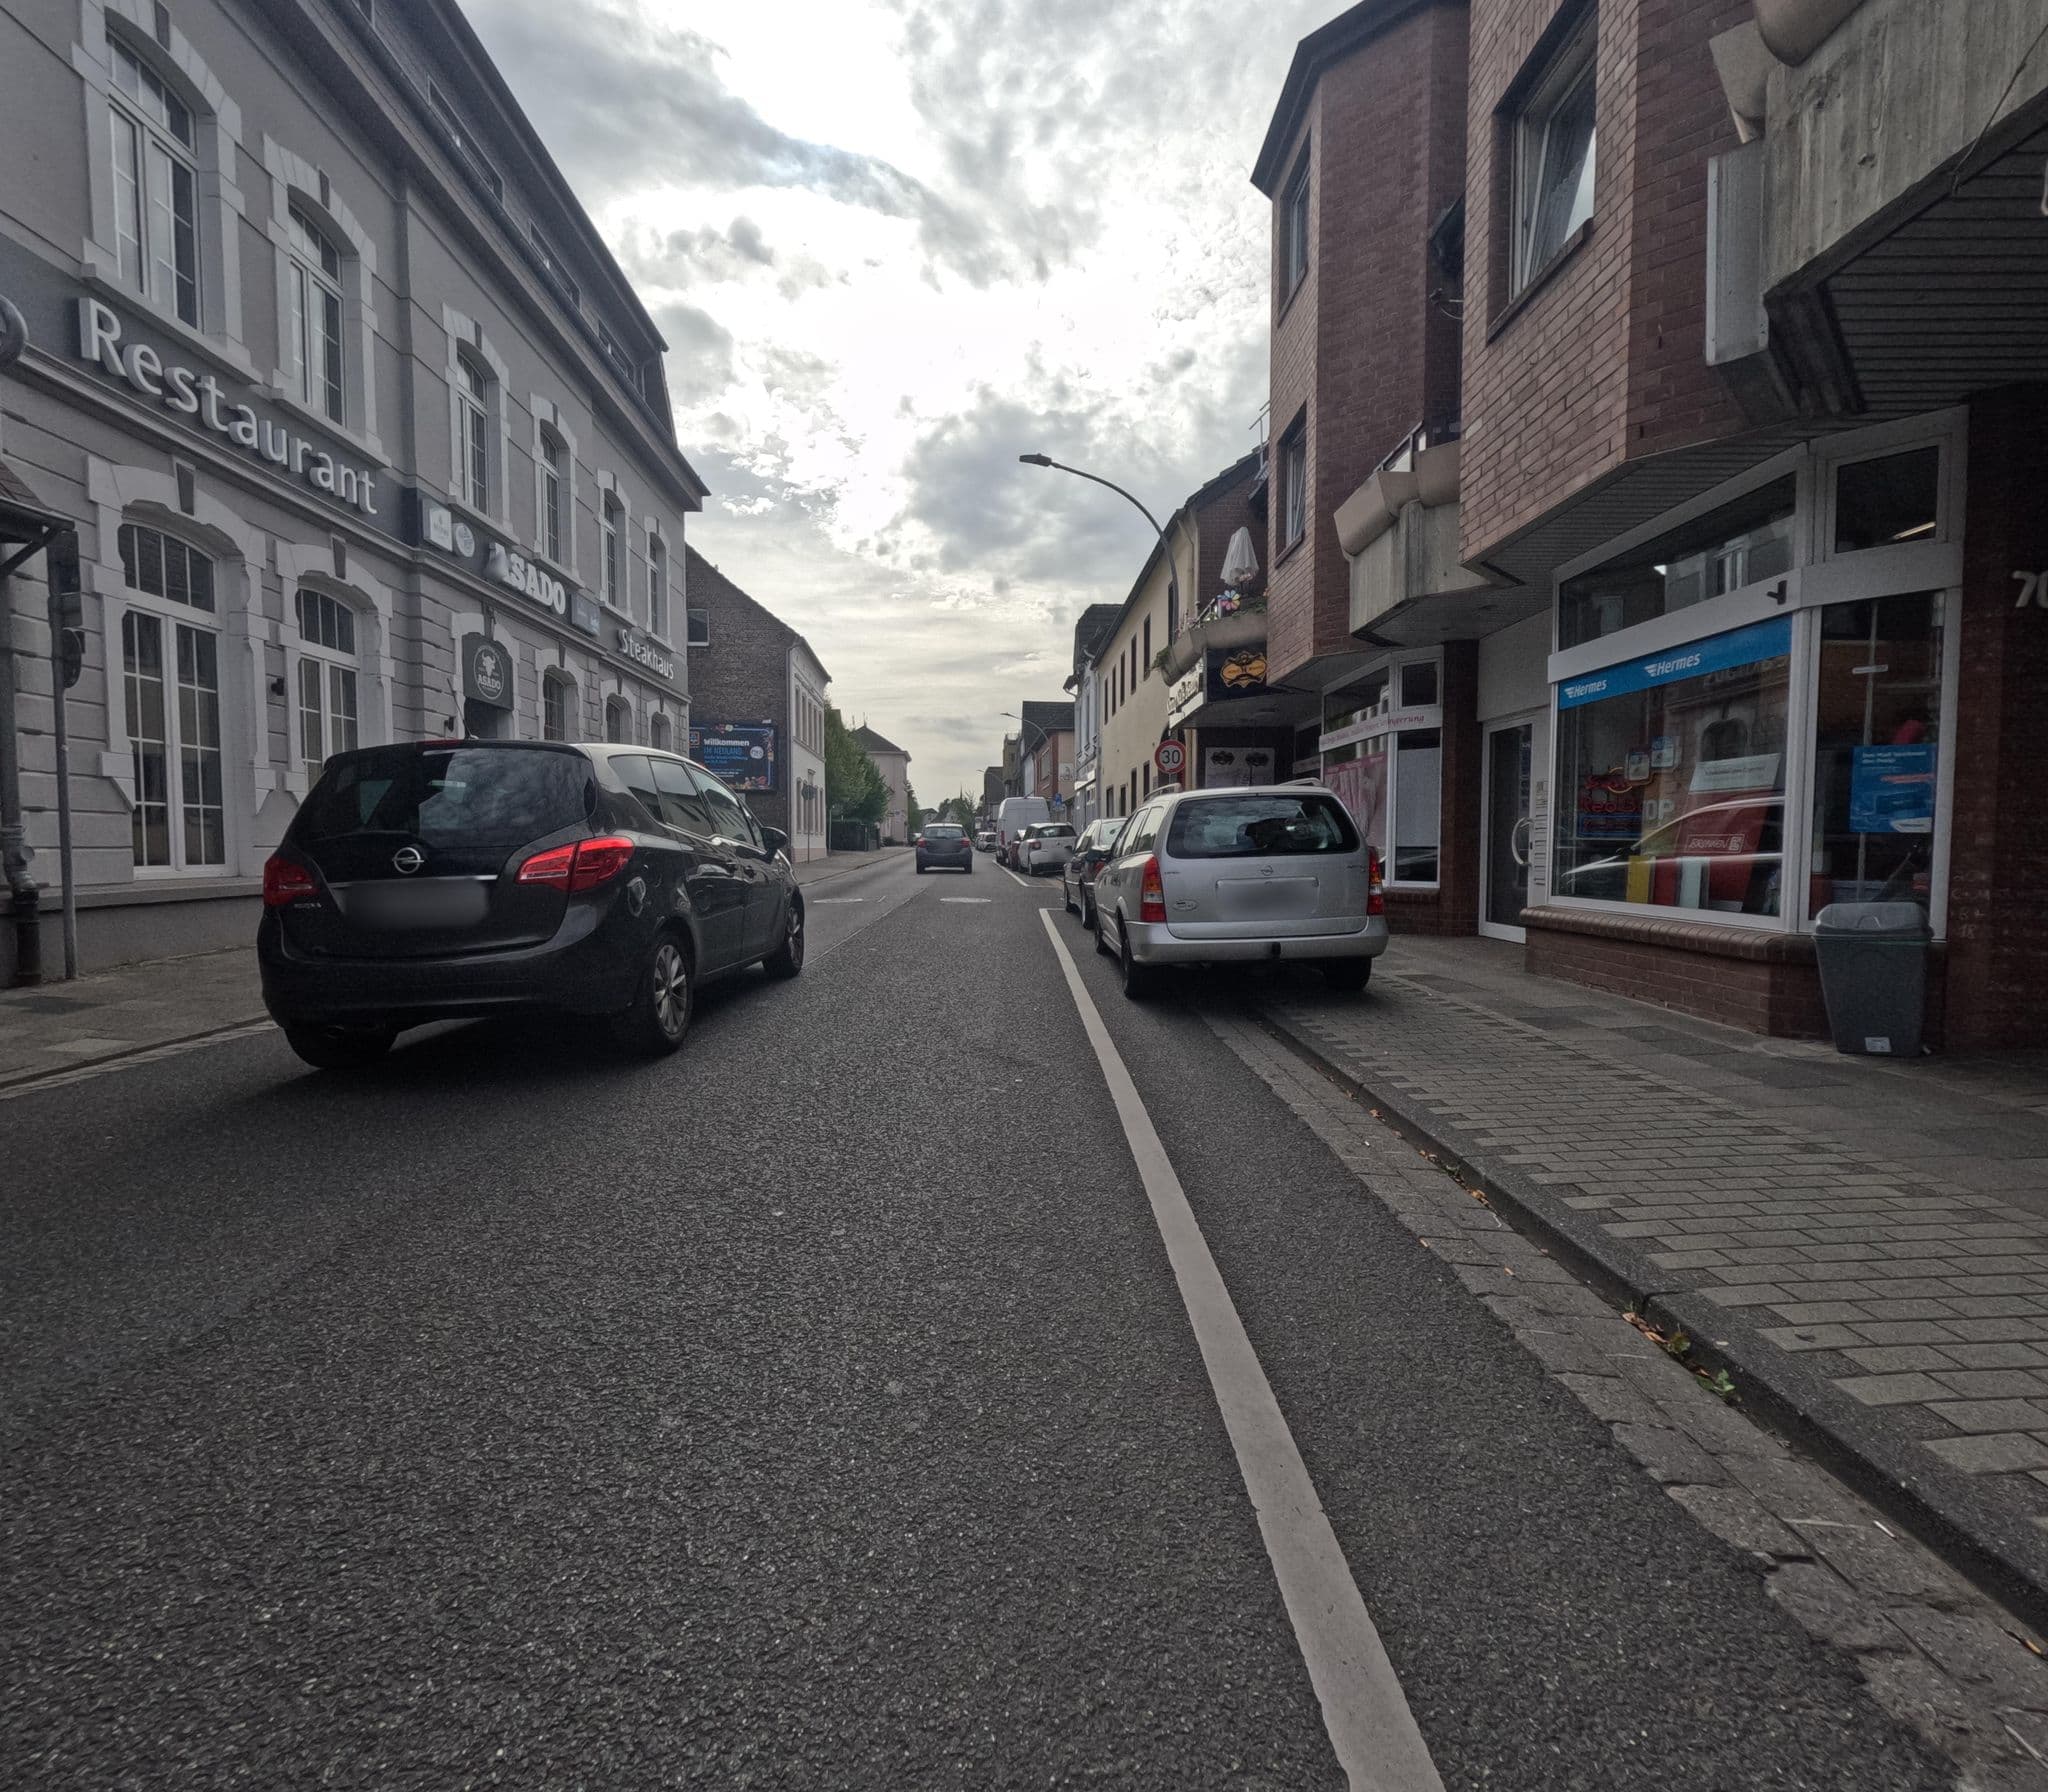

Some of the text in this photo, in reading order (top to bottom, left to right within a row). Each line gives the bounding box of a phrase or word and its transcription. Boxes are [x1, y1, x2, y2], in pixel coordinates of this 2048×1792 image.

[78, 297, 378, 515] Restaurant
[487, 542, 566, 615] ASADO
[618, 628, 675, 680] Steakhaus
[1657, 653, 1701, 676] Hermes
[477, 674, 501, 690] ASADO
[1574, 680, 1608, 697] Hermes
[1161, 750, 1181, 765] 30
